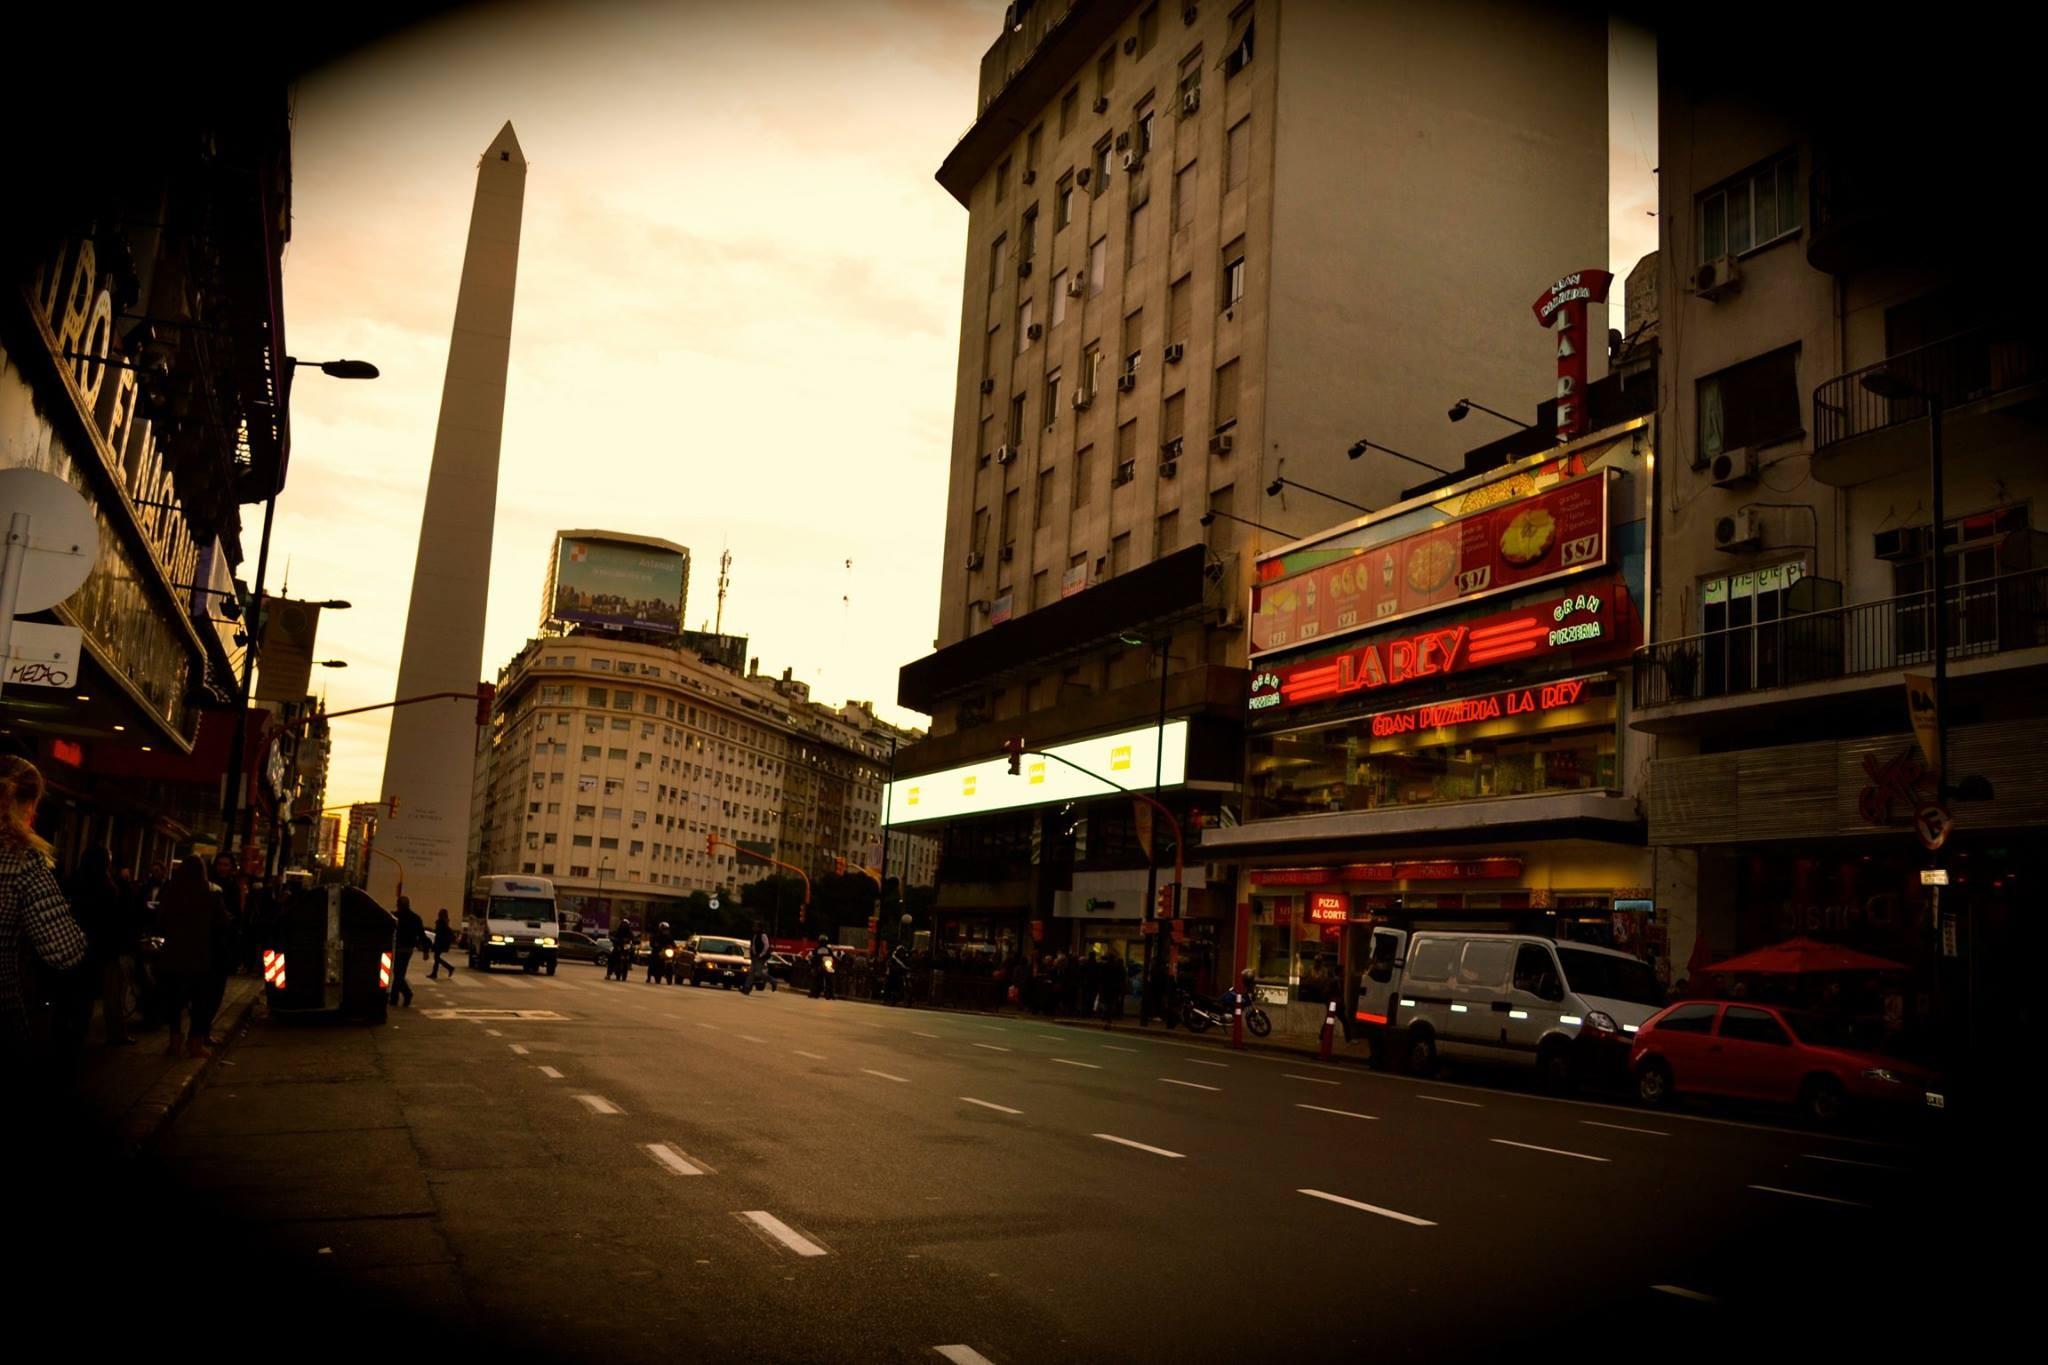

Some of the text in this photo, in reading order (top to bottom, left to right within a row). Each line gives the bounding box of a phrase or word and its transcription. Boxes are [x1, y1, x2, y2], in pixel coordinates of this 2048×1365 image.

[1554, 594, 1599, 621] GRAN
[1549, 621, 1600, 647] PIZZERIA
[1337, 625, 1468, 693] LA REY
[1251, 674, 1279, 692] GRAN
[1249, 692, 1280, 709] PIZZERIA
[1371, 681, 1582, 736] GRAN PIZZERIA LA REY
[1311, 908, 1347, 920] AL CORTE
[1318, 898, 1340, 909] PIZZA
